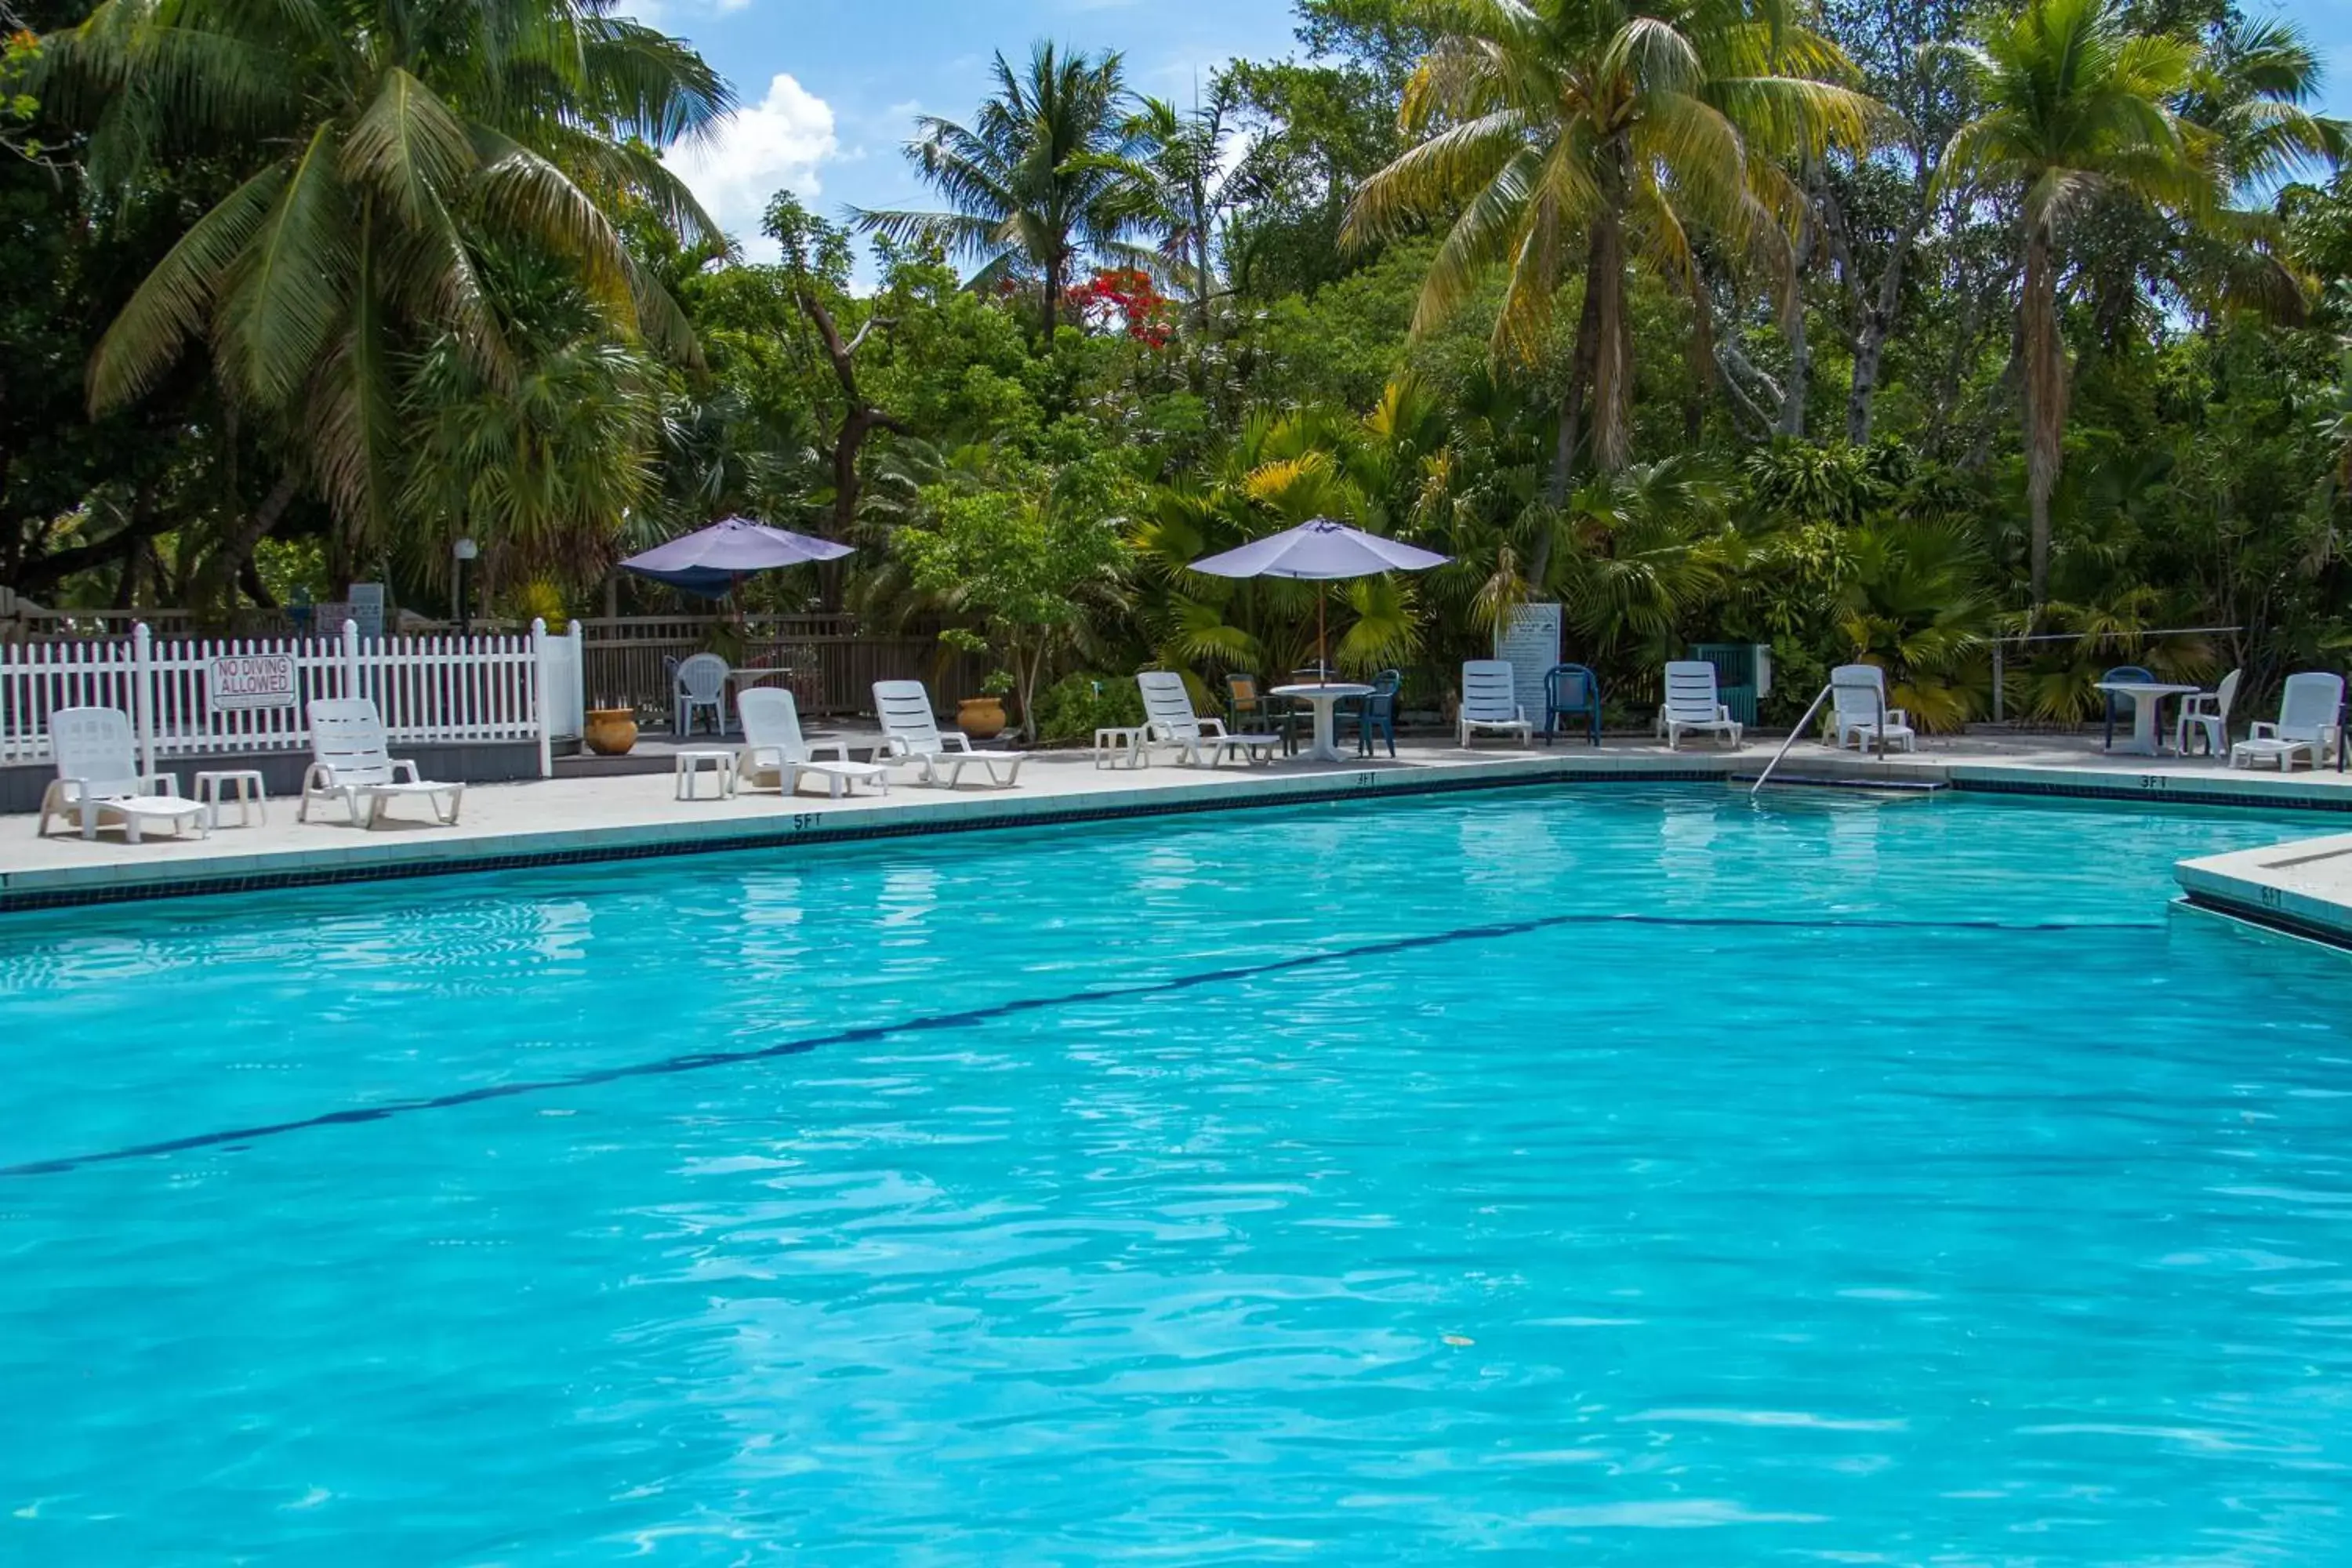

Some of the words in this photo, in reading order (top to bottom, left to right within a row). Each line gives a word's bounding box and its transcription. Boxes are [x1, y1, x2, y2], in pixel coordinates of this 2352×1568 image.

[218, 660, 238, 677] NO
[242, 658, 288, 676] DIVING
[222, 675, 288, 692] ALLOWED
[794, 812, 822, 830] 5FT
